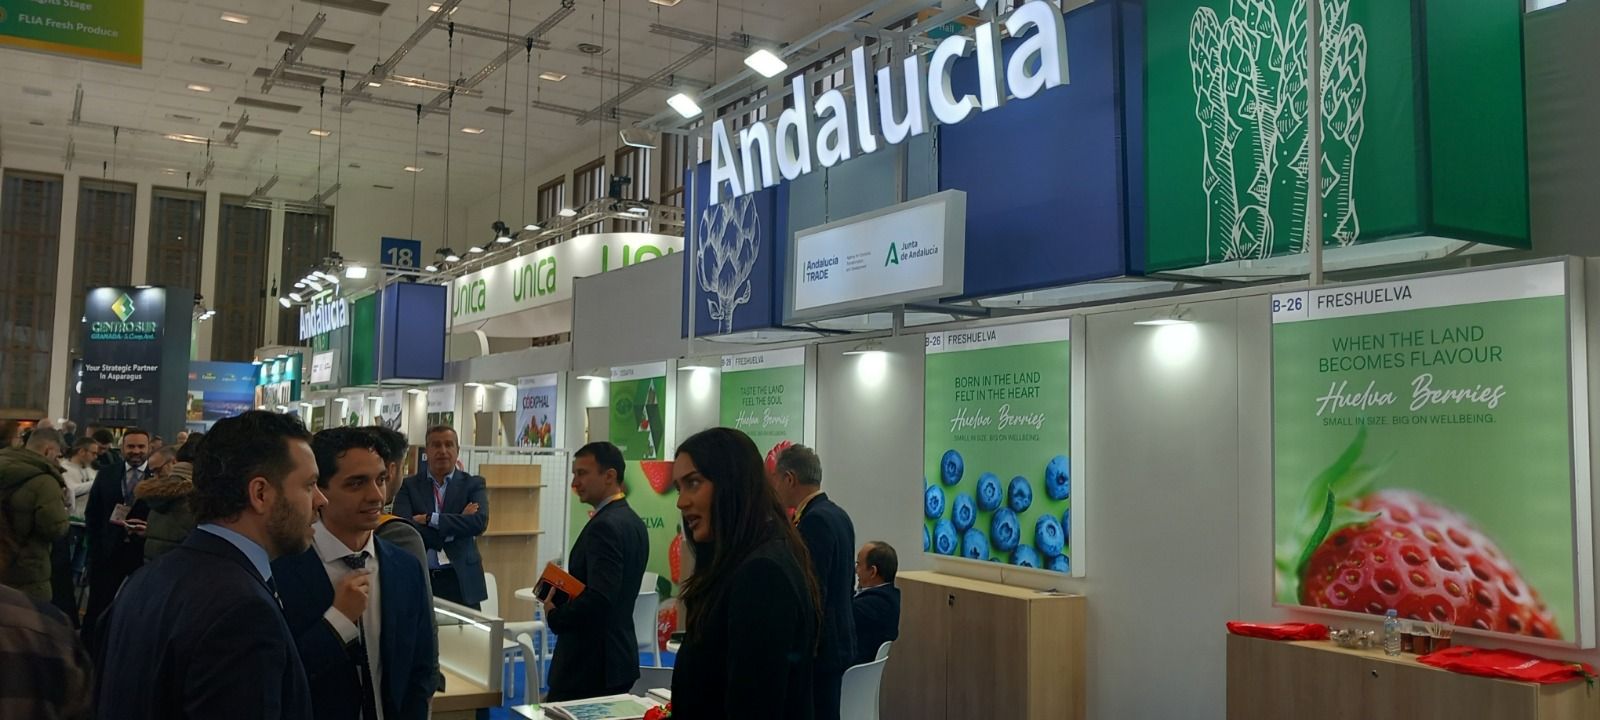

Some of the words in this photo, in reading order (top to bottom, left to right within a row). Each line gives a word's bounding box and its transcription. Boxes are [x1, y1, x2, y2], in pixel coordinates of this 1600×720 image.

[63, 0, 93, 11] Stage
[45, 18, 74, 31] Fresh
[76, 23, 120, 38] Produce
[901, 240, 918, 252] Junta
[901, 252, 908, 261] de
[909, 244, 938, 260] Andalucía
[388, 247, 413, 268] 18
[806, 255, 839, 271] Andalucía
[806, 268, 829, 282] TRADE
[1272, 297, 1303, 313] B-26
[1317, 285, 1412, 309] FRESHUELVA
[948, 330, 997, 345] FRESHUELVA
[1332, 333, 1386, 353] WHEN
[1389, 330, 1425, 348] THE
[1430, 325, 1485, 345] LAND
[1319, 352, 1406, 373] BECOMES
[1410, 345, 1503, 367] FLAVOUR
[85, 364, 101, 372] Your
[102, 364, 131, 374] Strategic
[132, 364, 158, 372] Partner
[107, 373, 142, 381] Asparagus
[955, 376, 981, 388] BORN
[982, 375, 992, 386] IN
[994, 374, 1012, 385] THE
[1013, 371, 1041, 385] LAND
[955, 390, 975, 402] FELT
[976, 389, 986, 400] IN
[987, 388, 1006, 400] THE
[1007, 386, 1041, 399] HEART
[1316, 380, 1399, 416] Huelva
[1409, 372, 1507, 412] Berries
[950, 407, 992, 433] Huelva
[997, 403, 1046, 431] Berries
[1322, 416, 1352, 427] SMALL
[1354, 417, 1366, 426] IN
[1391, 415, 1410, 425] BIG
[1411, 415, 1428, 425] ON
